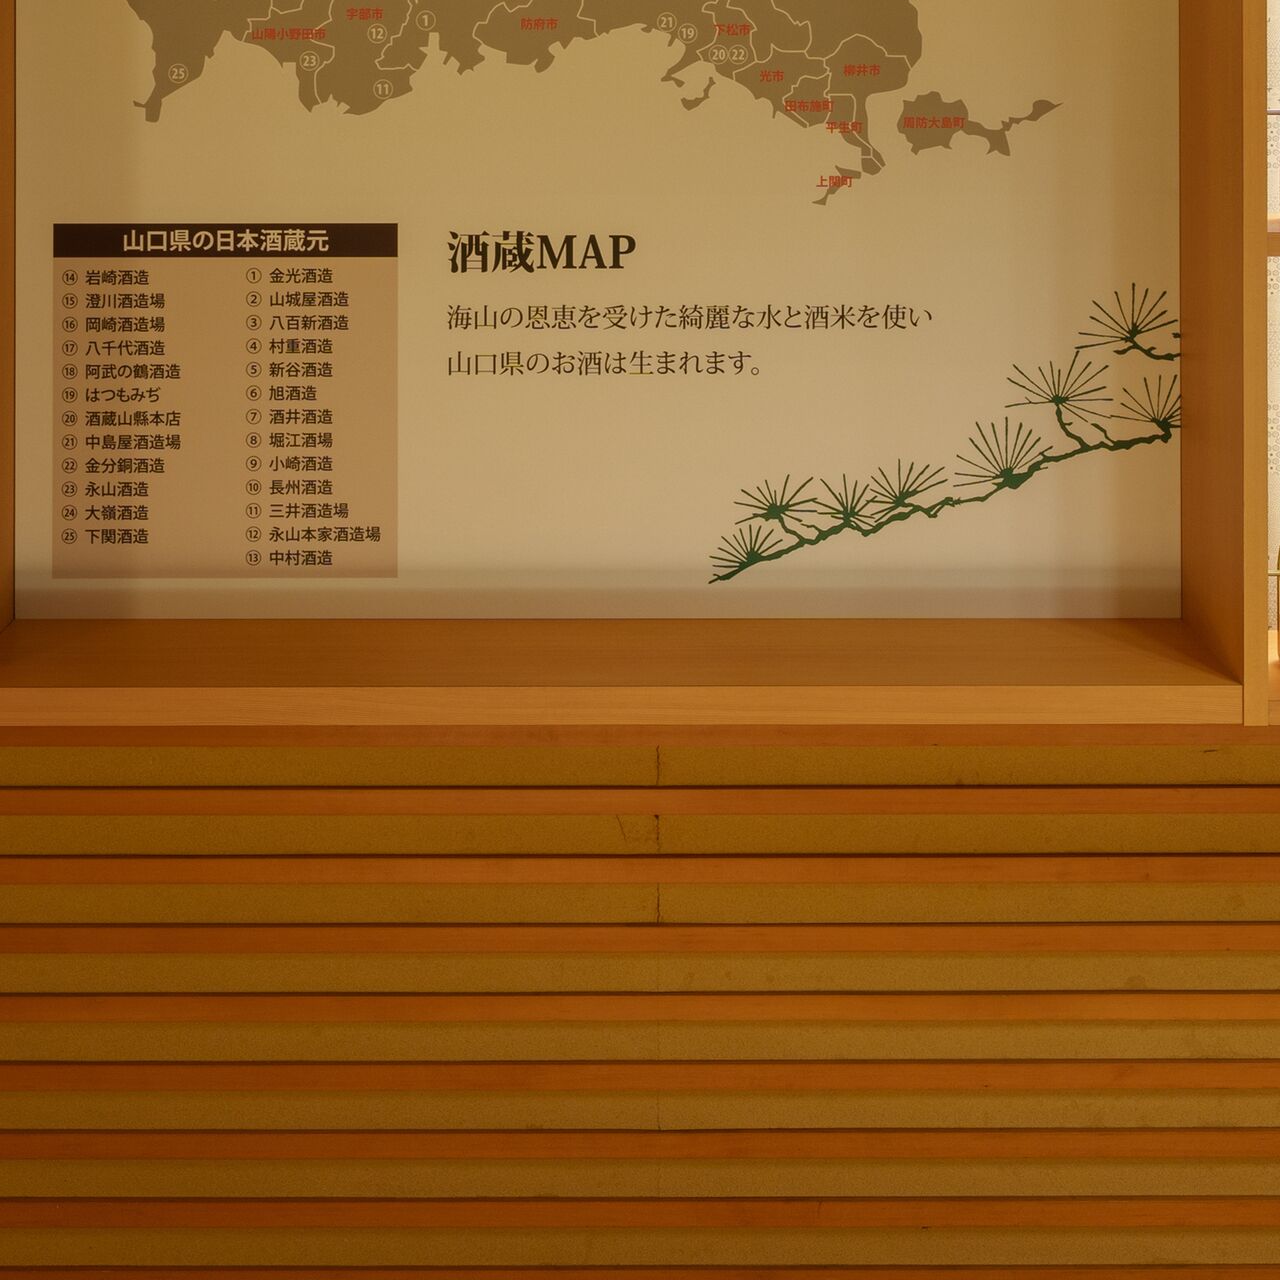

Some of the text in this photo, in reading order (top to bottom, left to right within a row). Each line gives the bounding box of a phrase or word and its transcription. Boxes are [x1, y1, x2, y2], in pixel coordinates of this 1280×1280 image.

[346, 8, 383, 20] 宇部市
[520, 17, 558, 30] 防府市
[714, 23, 750, 36] 下松市
[252, 28, 326, 40] 山陽小野田市
[760, 70, 784, 83] 光市
[843, 64, 880, 76] 柳井市
[825, 121, 863, 134] 平生町
[903, 117, 965, 129] 周防大島町
[816, 175, 852, 188] 上関町
[123, 229, 329, 252] 山口県の日本酒蔵元
[447, 230, 637, 273] 酒蔵MAP
[85, 270, 149, 286] 岩崎酒造
[269, 268, 333, 284] 金光酒造
[85, 293, 165, 309] 澄川酒造場
[269, 291, 349, 307] 山城屋酒造
[85, 317, 165, 333] 岡崎酒造場
[269, 315, 349, 331] 八百新酒造
[446, 304, 933, 330] 海山の恩恵を受けた綺麗な水と酒米を使い
[85, 340, 165, 356] 八千代酒造
[269, 338, 333, 354] 村重酒造
[269, 362, 333, 378] 新谷酒造
[447, 350, 761, 375] 山口県のお酒は生まれます。
[85, 364, 181, 380] 阿武の鶴酒造
[85, 387, 160, 403] はつもみぢ
[269, 385, 317, 401] 旭酒造
[85, 411, 181, 427] 酒蔵山縣本店
[269, 409, 333, 425] 酒井酒造
[85, 434, 181, 450] 中島屋酒造場
[269, 432, 333, 448] 堀江酒場
[85, 457, 165, 473] 金分銅酒造
[85, 481, 149, 497] 永山酒造
[269, 479, 333, 495] 長州酒造
[85, 505, 149, 521] 大嶺酒造
[269, 503, 349, 519] 三井酒造場
[85, 528, 149, 544] 下関酒造
[269, 526, 381, 542] 永山本家酒造場
[269, 550, 333, 566] 中村酒造
